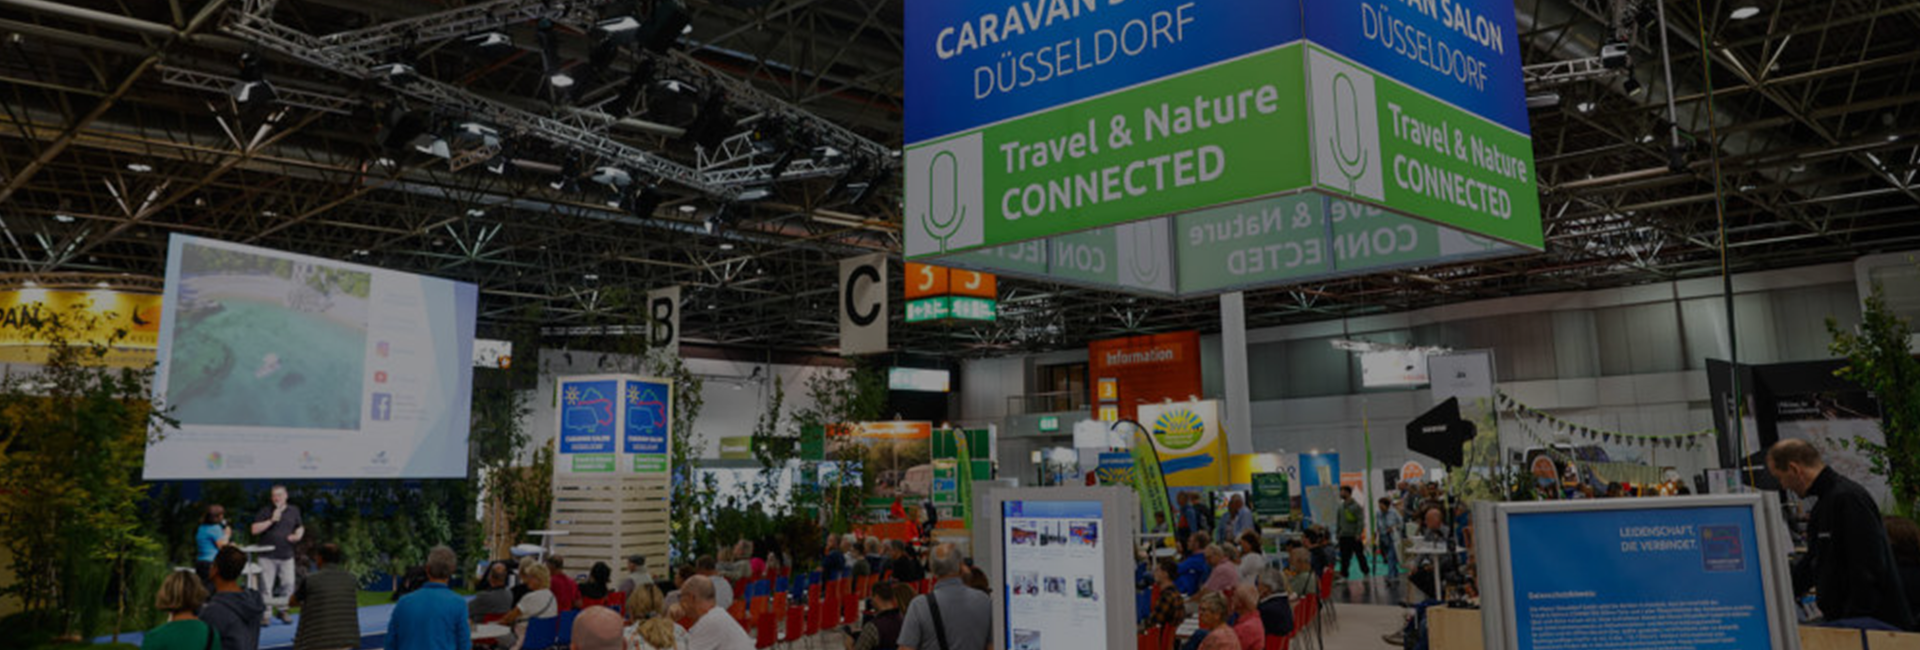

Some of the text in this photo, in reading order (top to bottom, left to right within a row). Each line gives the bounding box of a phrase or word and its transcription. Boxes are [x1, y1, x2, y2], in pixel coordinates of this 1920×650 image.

[973, 2, 1195, 100] DÜSSELDORF
[1361, 2, 1488, 93] DÜSSELDORF
[1441, 0, 1503, 55] SALON
[1000, 84, 1279, 174] Travel & Nature
[1387, 102, 1527, 184] Travel & Nature
[1001, 144, 1226, 220] CONNECTED
[1393, 154, 1512, 220] CONNECTED
[651, 297, 674, 347] B
[845, 265, 881, 327] C
[1106, 348, 1174, 366] Information
